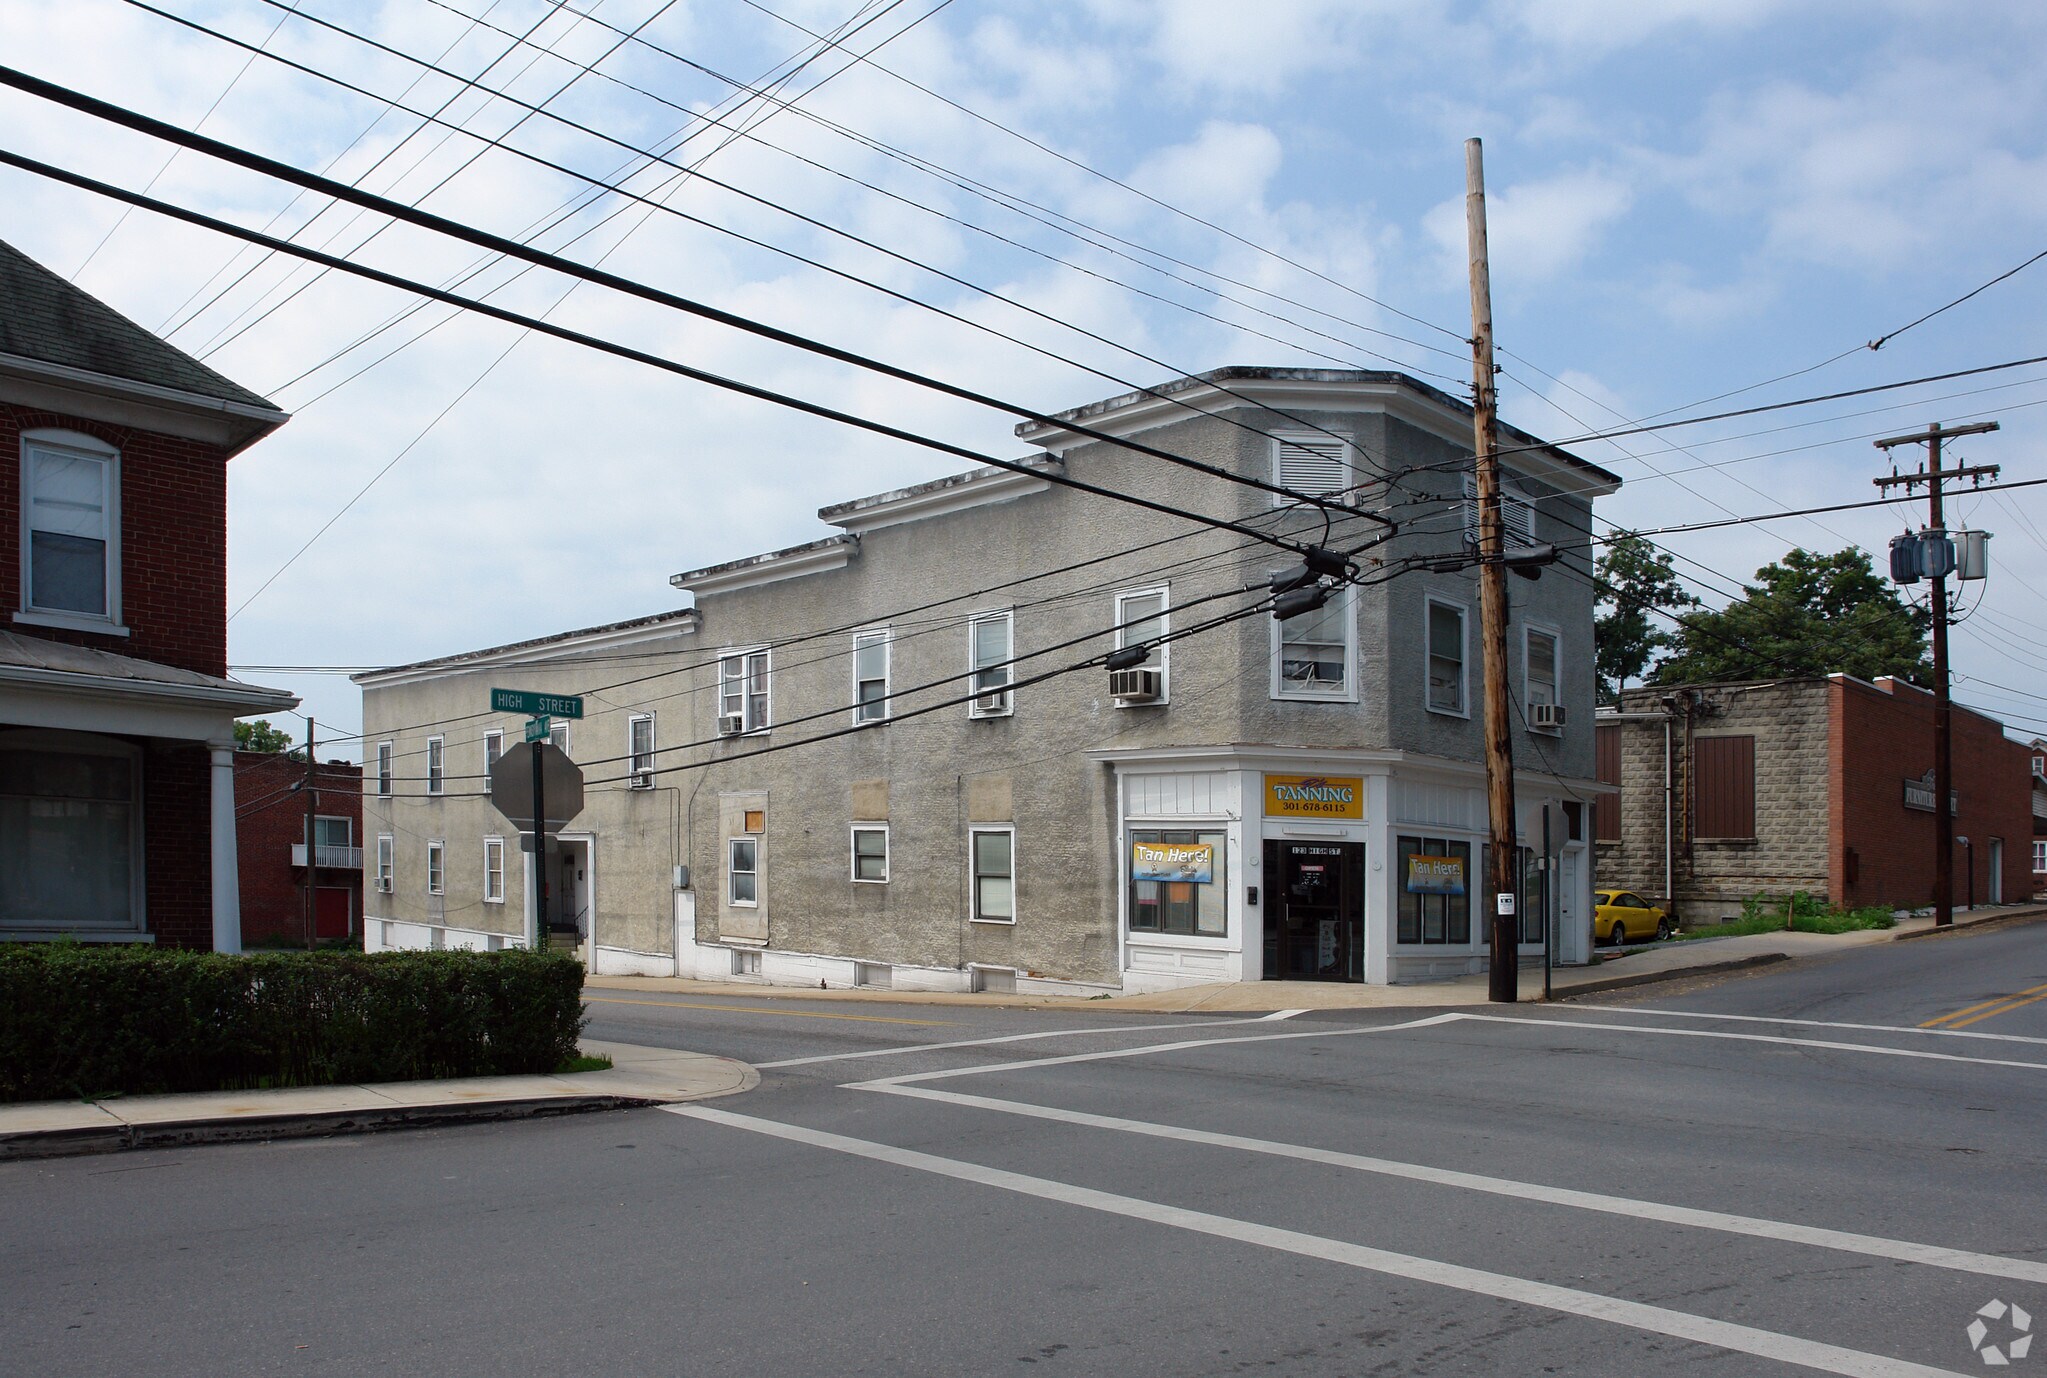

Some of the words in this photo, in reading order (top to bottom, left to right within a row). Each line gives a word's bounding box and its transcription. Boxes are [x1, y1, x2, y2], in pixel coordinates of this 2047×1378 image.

[498, 693, 522, 708] HIGH
[539, 697, 577, 713] STREET
[1273, 785, 1352, 803] TANNING
[1283, 802, 1345, 812] 301-678-6115
[1137, 846, 1164, 861] Tan
[1167, 847, 1208, 863] Here!
[1411, 859, 1430, 874] Tan
[1433, 860, 1460, 875] Here!
